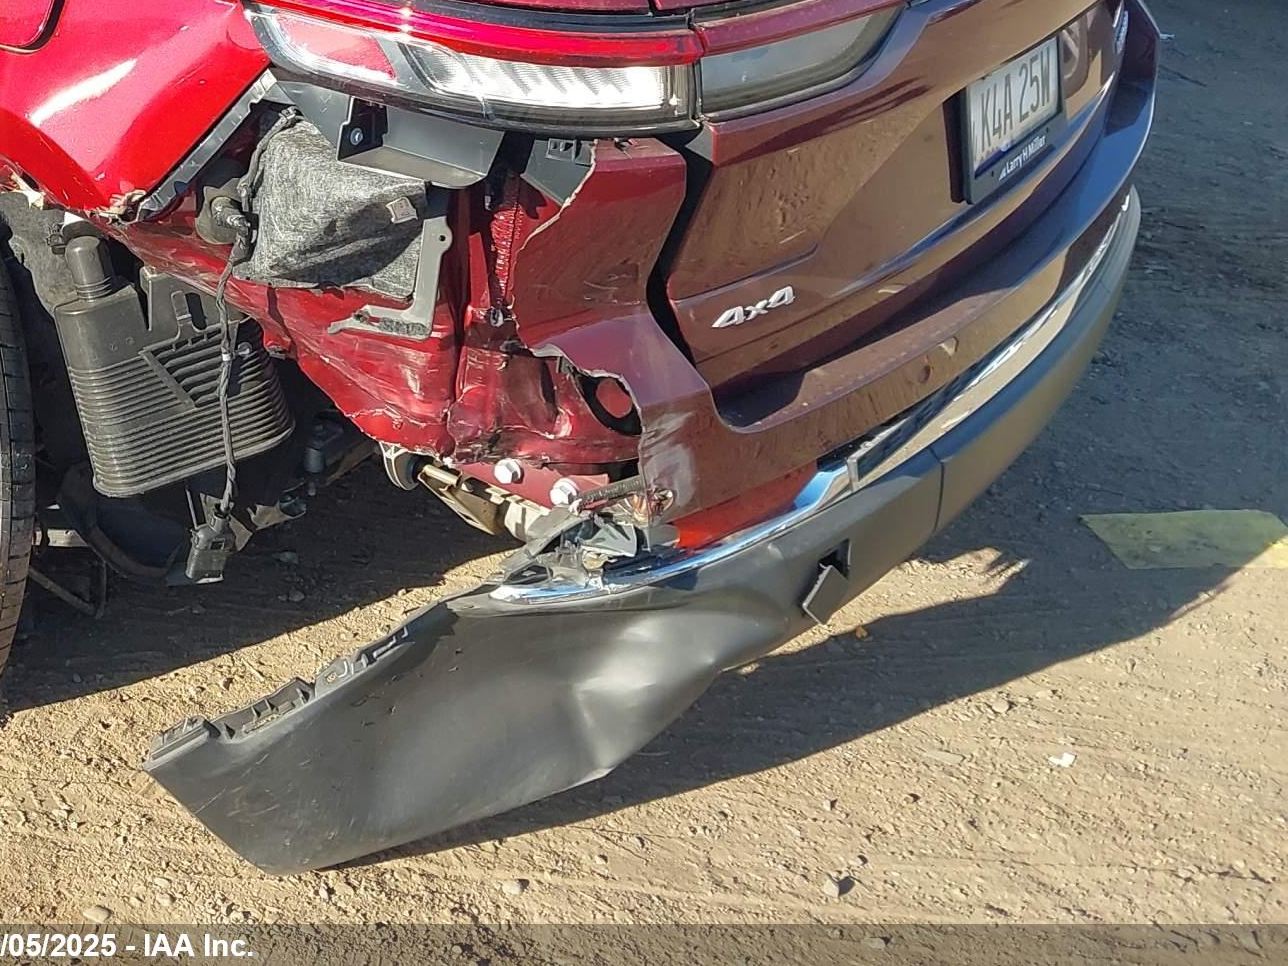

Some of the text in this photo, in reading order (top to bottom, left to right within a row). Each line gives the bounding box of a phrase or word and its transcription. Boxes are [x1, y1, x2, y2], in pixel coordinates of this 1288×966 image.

[980, 73, 1013, 152] K4A
[1006, 153, 1023, 174] Larry
[1028, 135, 1046, 157] Miller
[712, 285, 795, 328] 4x4
